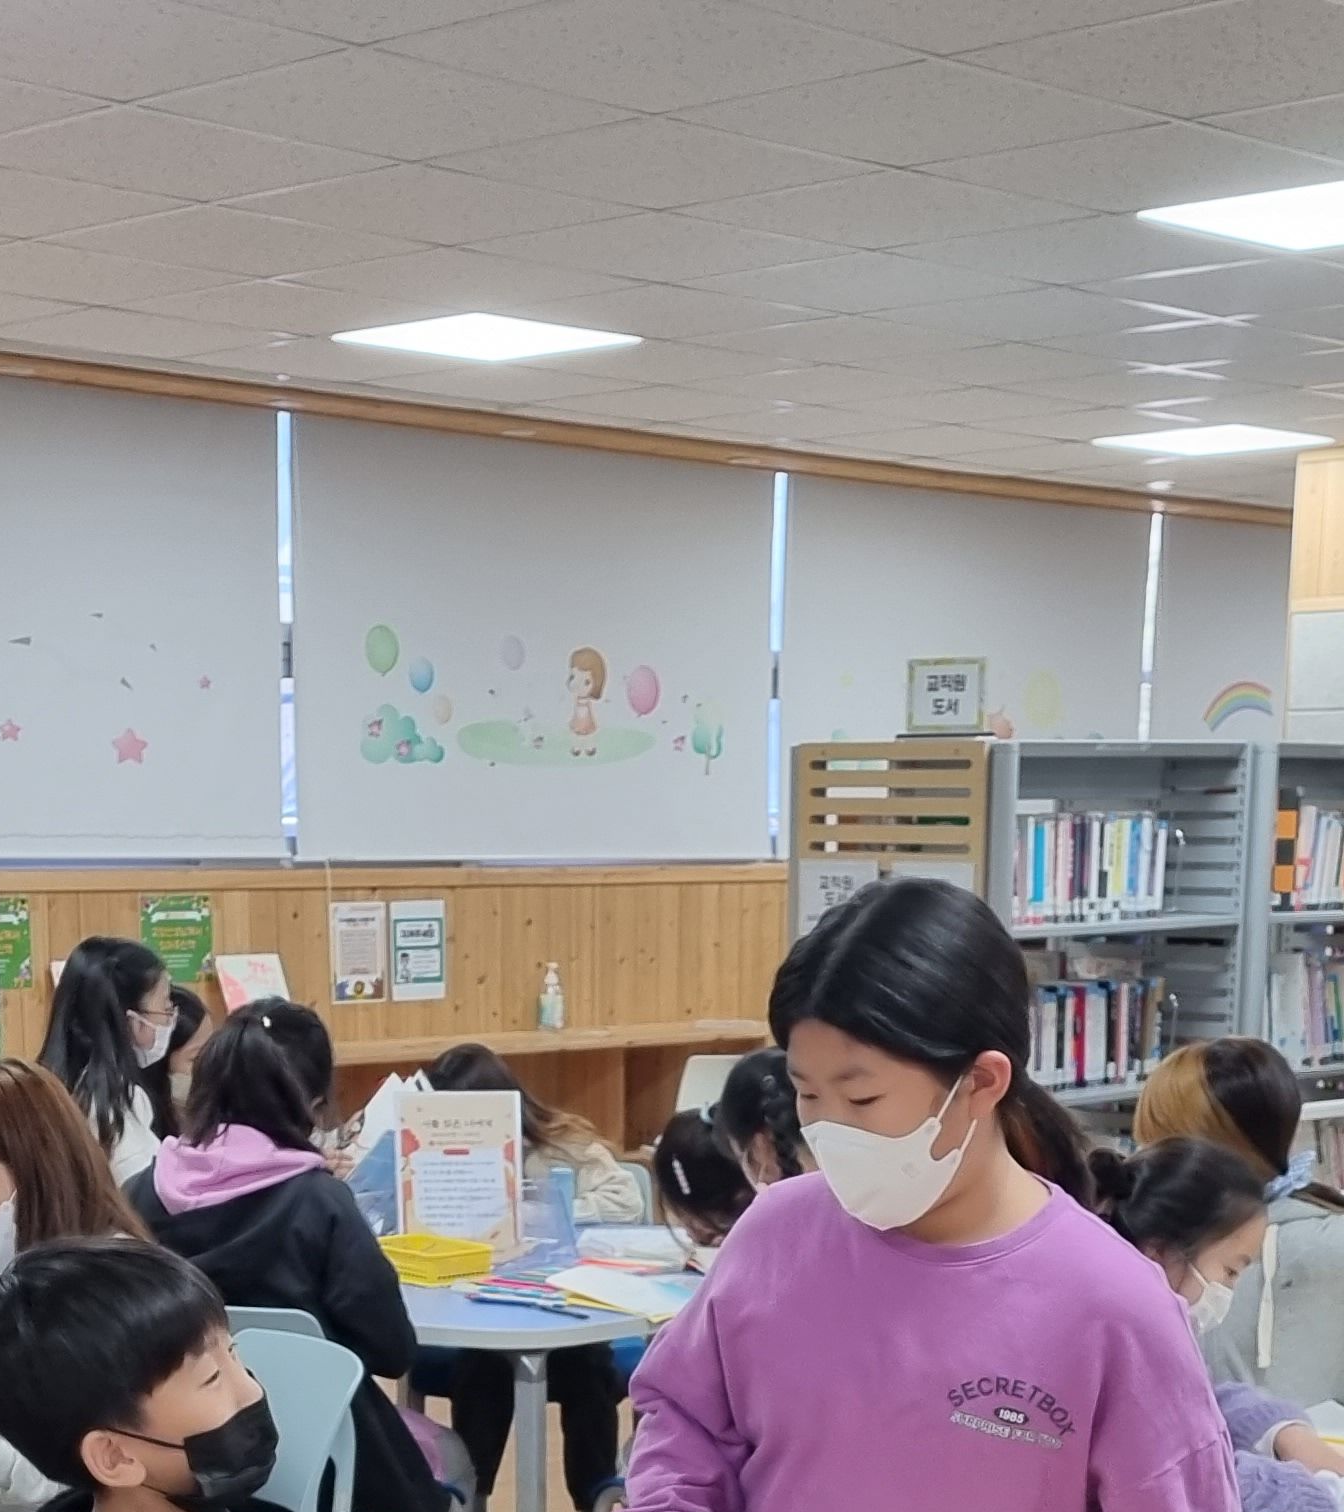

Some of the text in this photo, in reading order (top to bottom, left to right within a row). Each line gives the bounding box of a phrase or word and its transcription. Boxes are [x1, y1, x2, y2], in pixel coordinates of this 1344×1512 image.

[926, 674, 967, 692] 교직원
[931, 698, 960, 716] 도서
[819, 875, 854, 891] 교직원
[947, 1376, 1076, 1437] SECRETBOX
